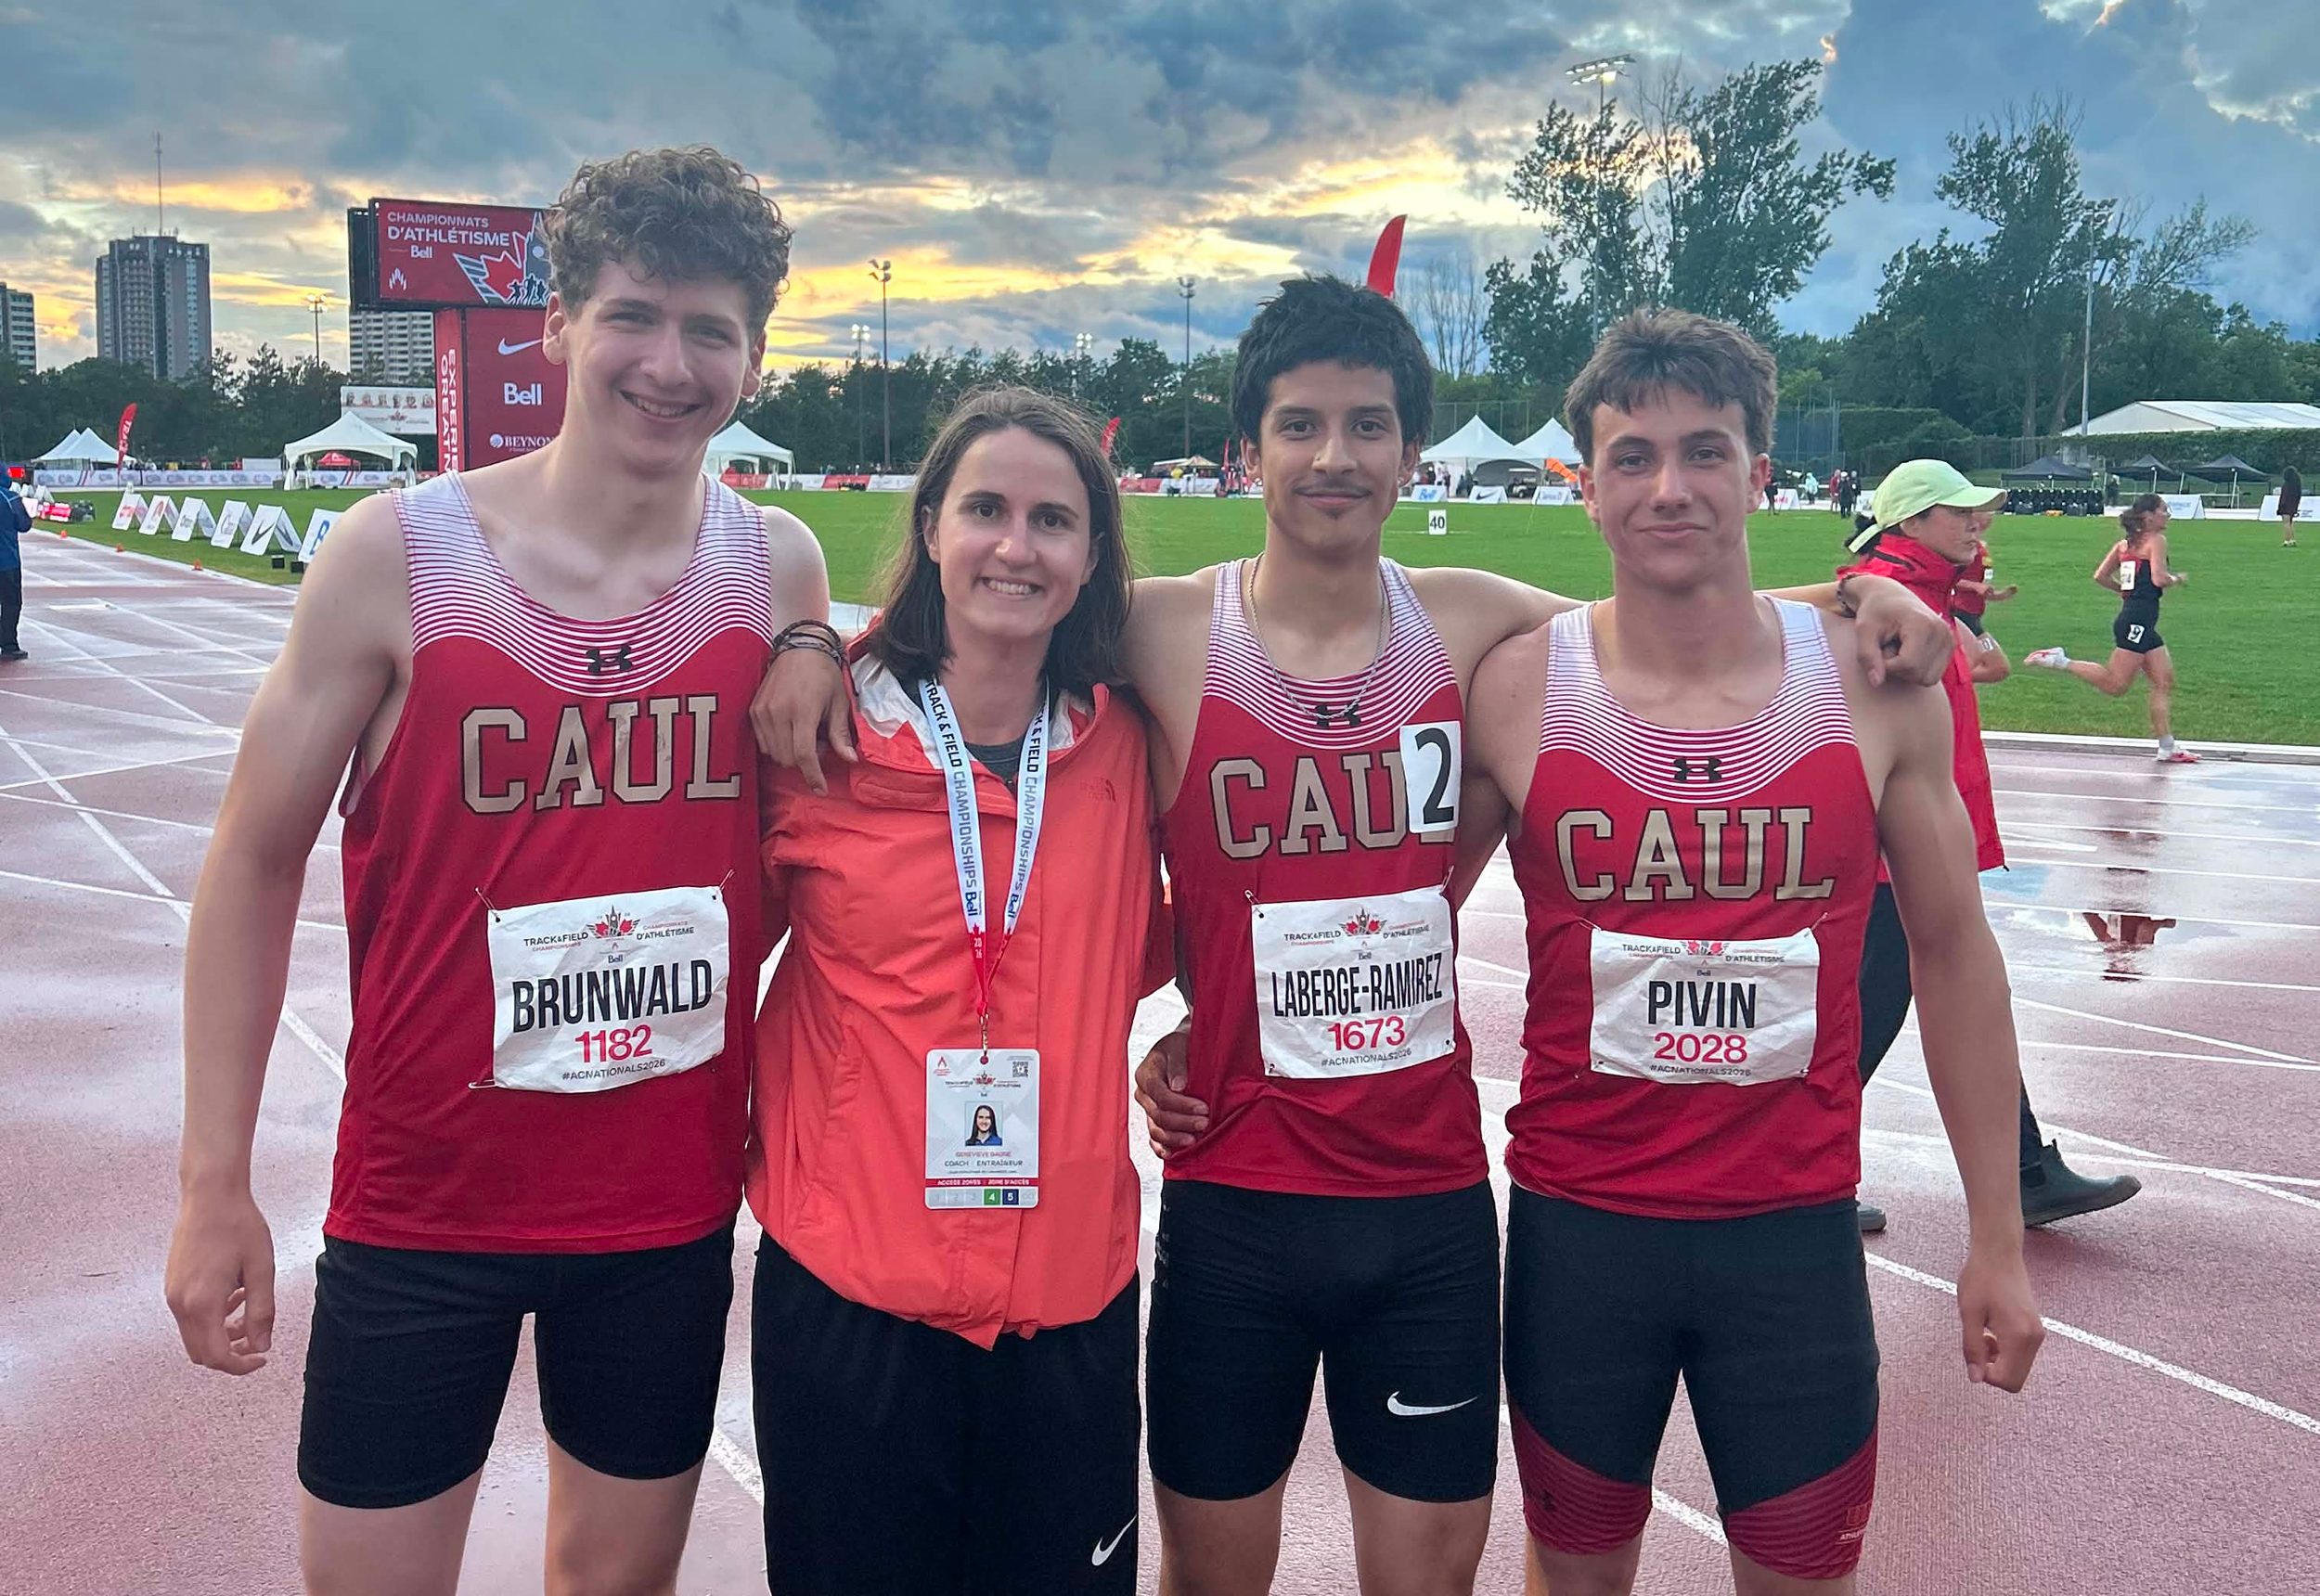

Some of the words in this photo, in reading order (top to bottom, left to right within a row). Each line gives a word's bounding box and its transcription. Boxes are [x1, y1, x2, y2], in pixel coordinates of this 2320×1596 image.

[387, 212, 489, 228] CHAMPIONNATS
[388, 225, 509, 246] D'ATHLÉTISME
[410, 245, 432, 259] Bell
[504, 382, 542, 405] Bell
[1429, 516, 1445, 530] 40
[461, 692, 742, 815] CAUL
[1026, 737, 1041, 772] FIELD
[1414, 727, 1455, 825] 2
[925, 680, 947, 722] TRACK
[942, 733, 962, 767] FIELD
[953, 771, 977, 888] CHAMPIONSHIPS
[965, 892, 977, 917] Bell
[1209, 750, 1455, 860] CAU
[1015, 777, 1038, 891] CHAMPIONSHIPS
[1555, 805, 1837, 903] CAUL
[1008, 894, 1020, 919] Bell
[523, 932, 588, 946] TRACK&FIELD
[1283, 930, 1341, 941] TRACK&FIELD
[1622, 944, 1682, 955] TRACK&FIELD
[608, 954, 624, 963] Bell
[512, 959, 712, 1034] BRUNWALD
[1271, 952, 1442, 1018] LABERGE-RAMIREZ
[1648, 980, 1756, 1029] PIVIN
[575, 1024, 652, 1063] 1182
[1328, 1016, 1405, 1051] 1673
[1321, 1048, 1411, 1066] #ACNATIONALS2026
[1654, 1032, 1747, 1064] 2028
[562, 1059, 665, 1081] #ACNATIONALS2026
[988, 1192, 996, 1201] 4
[1008, 1192, 1014, 1201] 5
